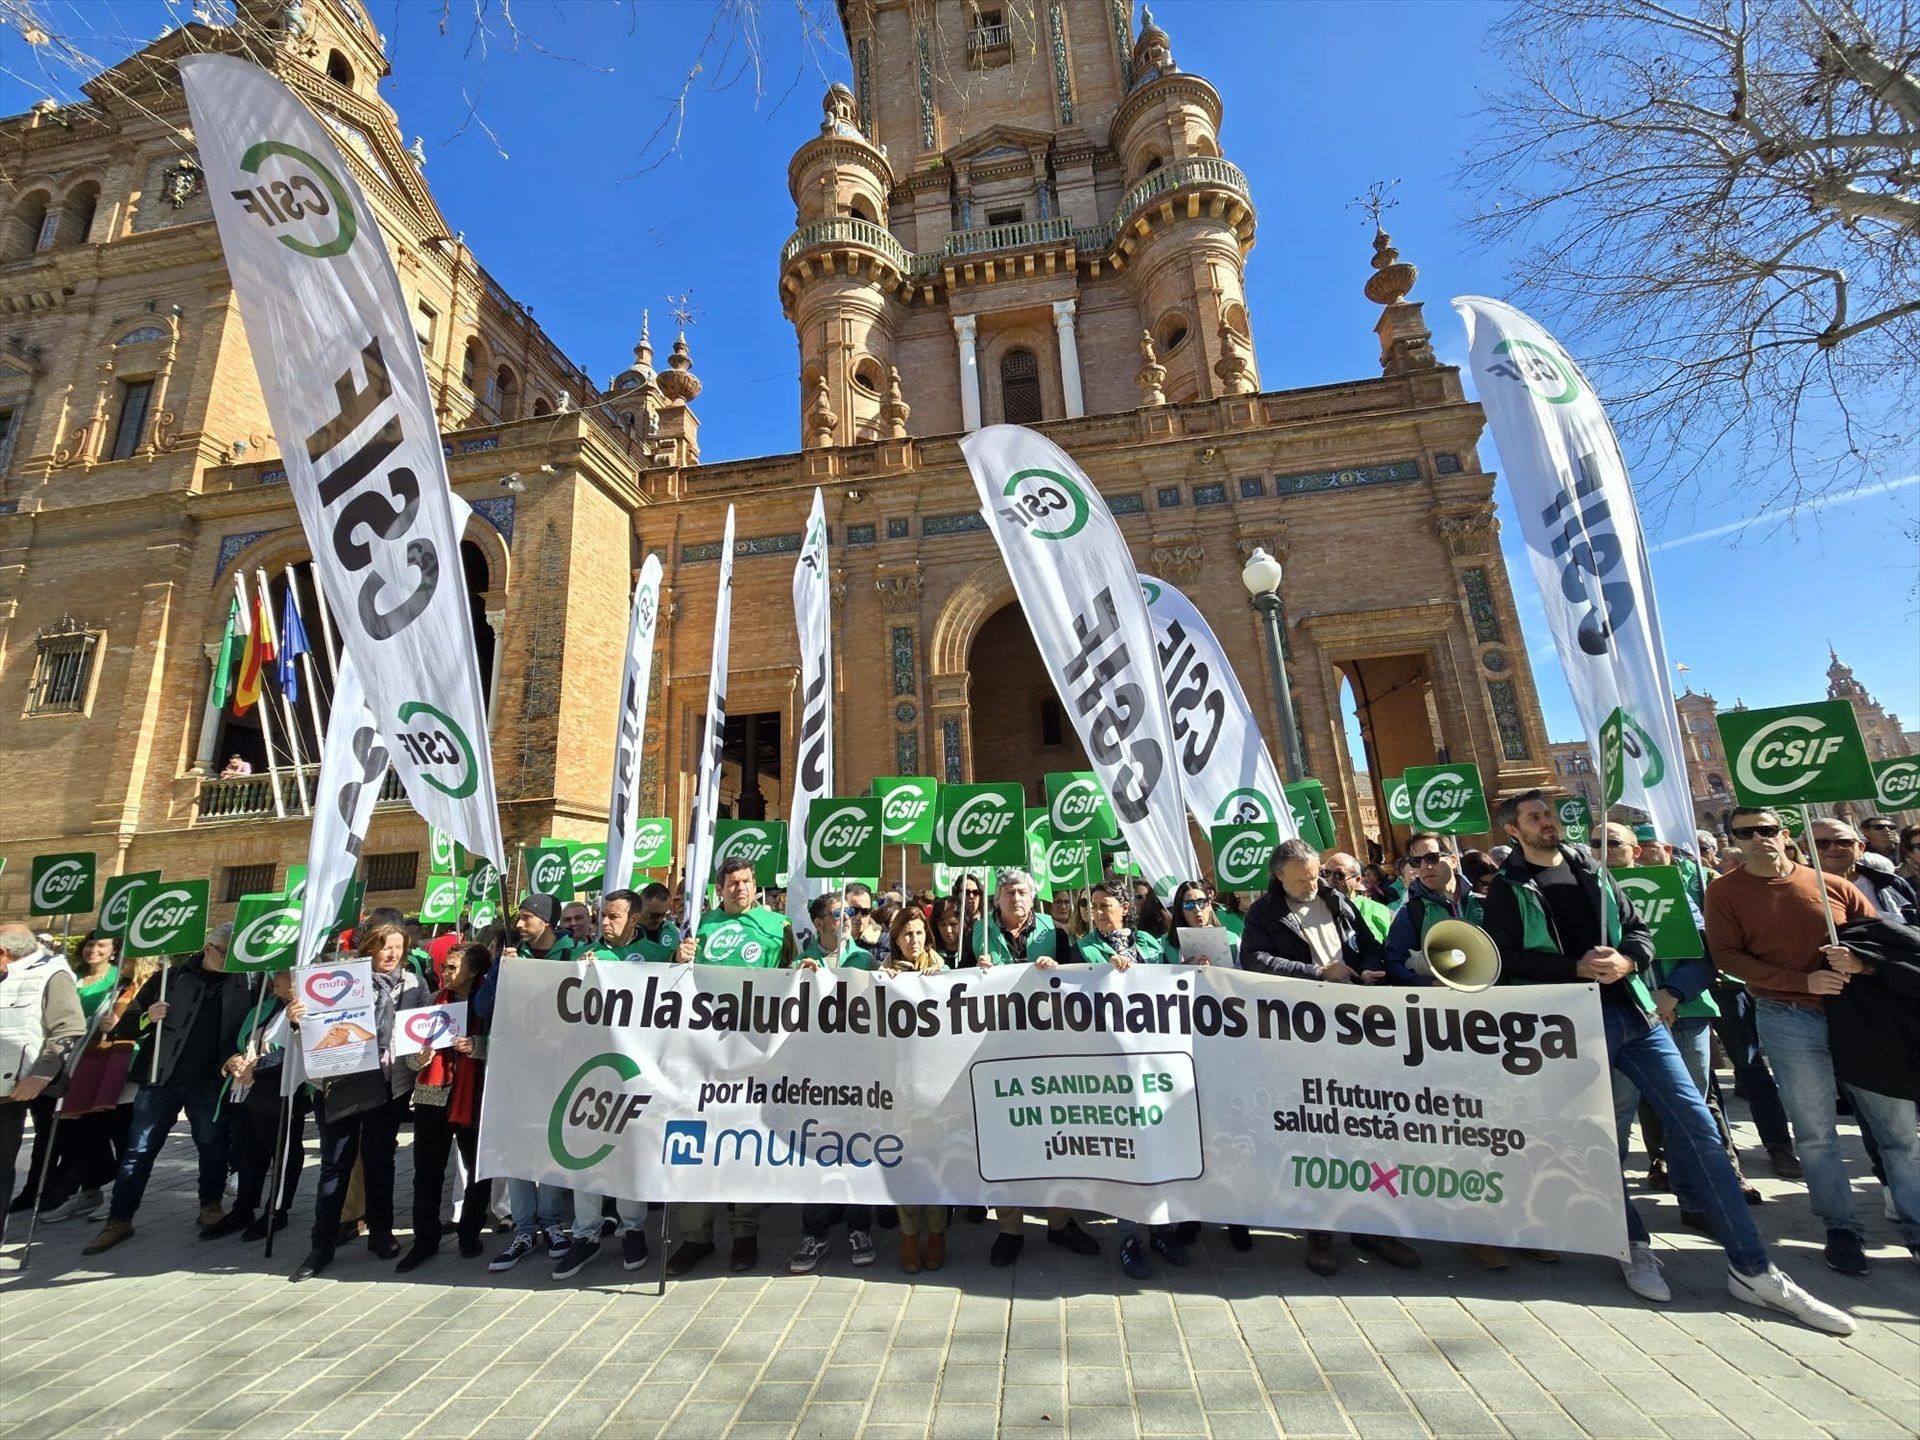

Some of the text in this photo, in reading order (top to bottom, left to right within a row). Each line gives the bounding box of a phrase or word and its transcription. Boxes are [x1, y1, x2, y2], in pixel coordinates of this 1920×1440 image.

[1757, 735, 1845, 769] CSIF
[1884, 773, 1920, 792] CSI
[886, 798, 929, 820] CSIF
[1063, 795, 1106, 815] CSIF
[1426, 788, 1473, 810] CSIF
[962, 813, 1014, 834] CSIF
[636, 834, 666, 850] CSIF
[824, 826, 873, 848] CSIF
[727, 842, 773, 861] CSIF
[1053, 846, 1092, 867] CSIF
[1229, 846, 1274, 866] CSIF
[538, 865, 567, 883] CSIF
[572, 859, 605, 875] CSIF
[45, 874, 88, 892] CSIF
[145, 905, 198, 929] CSIF
[1633, 898, 1675, 923] SIF
[713, 933, 748, 949] CSIF
[319, 977, 360, 989] muface
[556, 976, 1578, 1075] Con la salud de los funcionarios no se juega
[698, 1076, 894, 1113] por la defensa de
[994, 1072, 1174, 1098] LA SANIDAD ES
[1302, 1078, 1484, 1119] El futuro de tu
[569, 1087, 651, 1134] CSIF
[1008, 1104, 1164, 1127] UN DERECHO
[1273, 1105, 1527, 1157] salud está en riesgo
[712, 1118, 905, 1169] muface
[1045, 1130, 1137, 1160] ¡ÚNETE!
